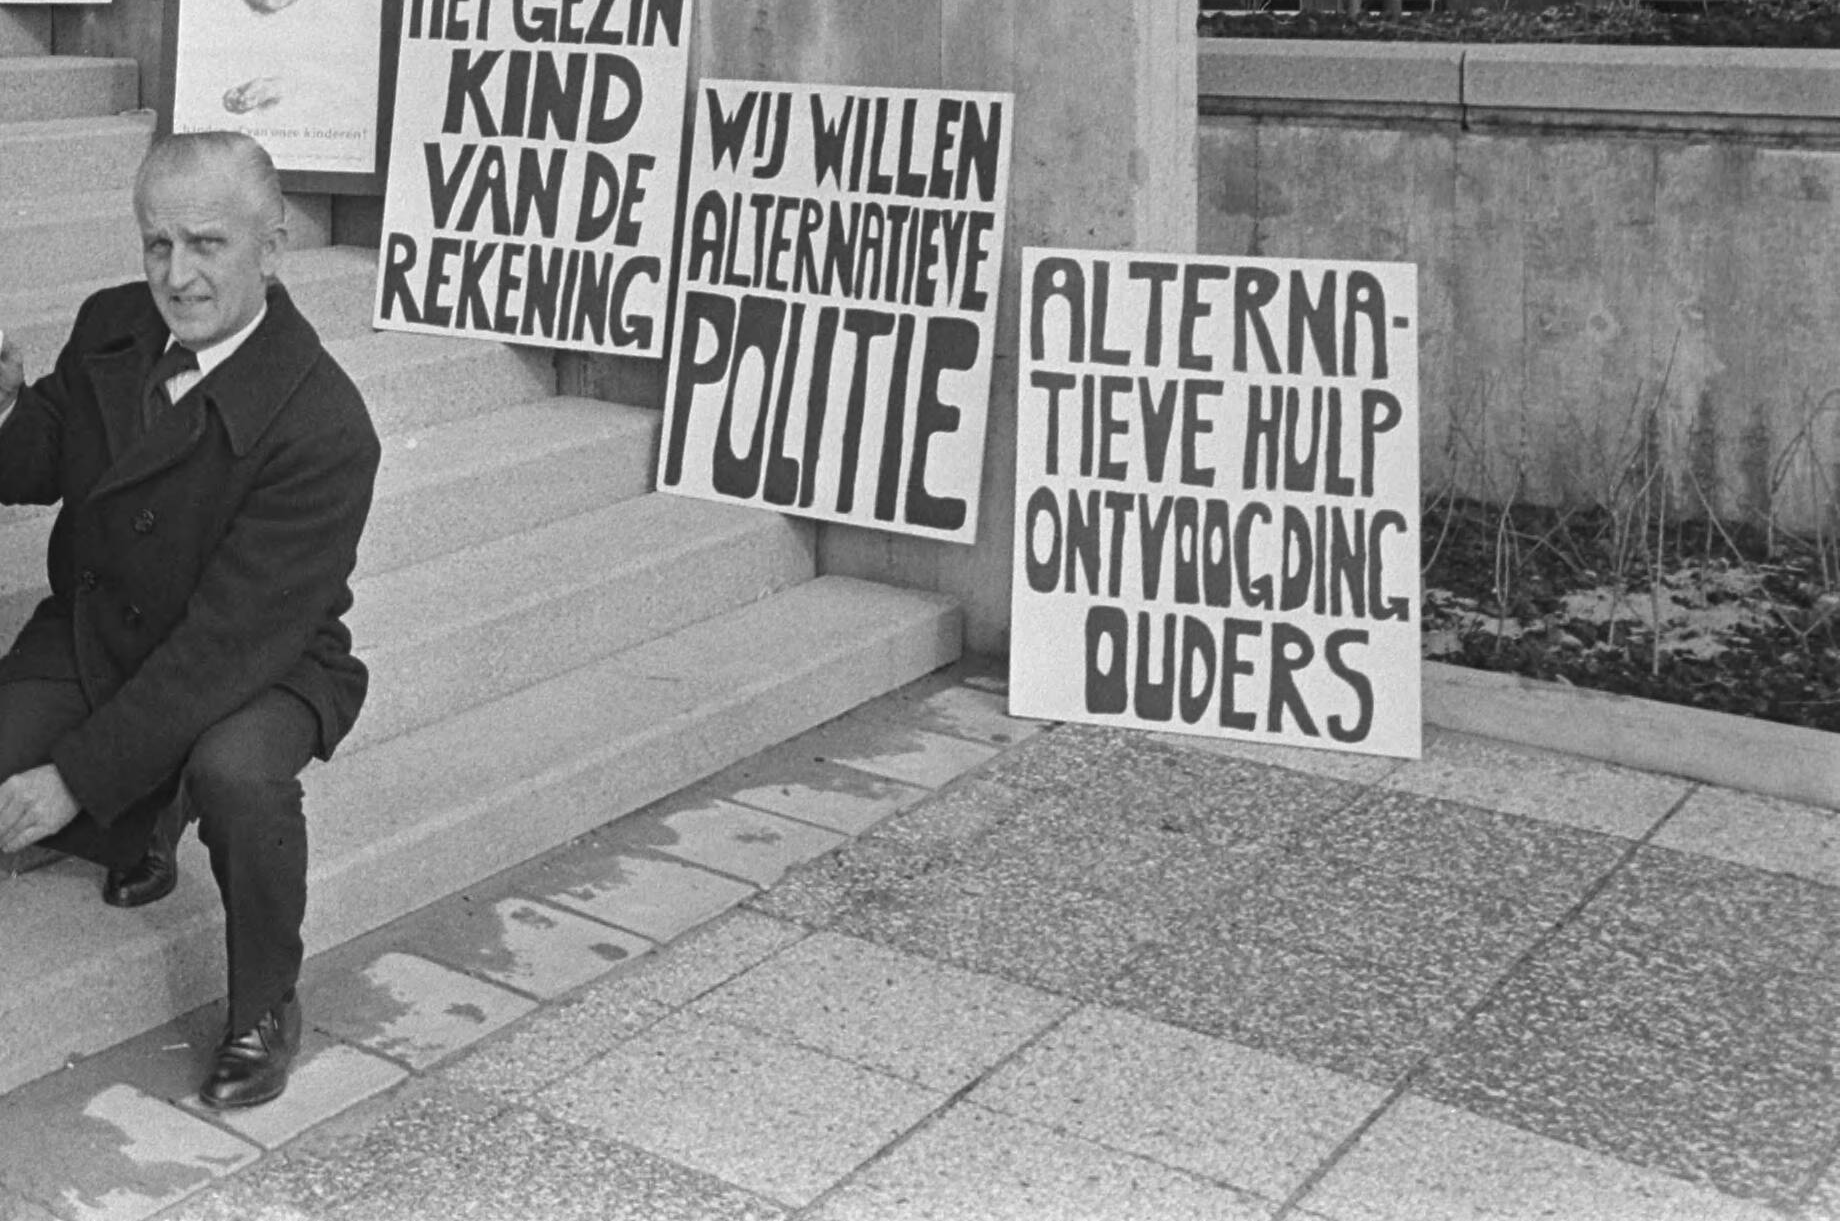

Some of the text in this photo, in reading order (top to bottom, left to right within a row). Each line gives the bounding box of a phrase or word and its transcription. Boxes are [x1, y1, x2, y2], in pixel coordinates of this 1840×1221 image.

[442, 48, 643, 144] KIND
[706, 88, 1002, 202] WIJ WILLEN
[424, 141, 656, 247] VAN DE
[687, 189, 995, 312] ALTERNATIEVE
[380, 233, 661, 350] REKENING
[1030, 256, 1409, 380] ALTERNA-
[663, 291, 980, 531] POLITIE
[1030, 369, 1402, 497] TIEVE HULP
[1025, 485, 1410, 622] ONTVOOGDING
[1084, 605, 1375, 743] OUDERS
